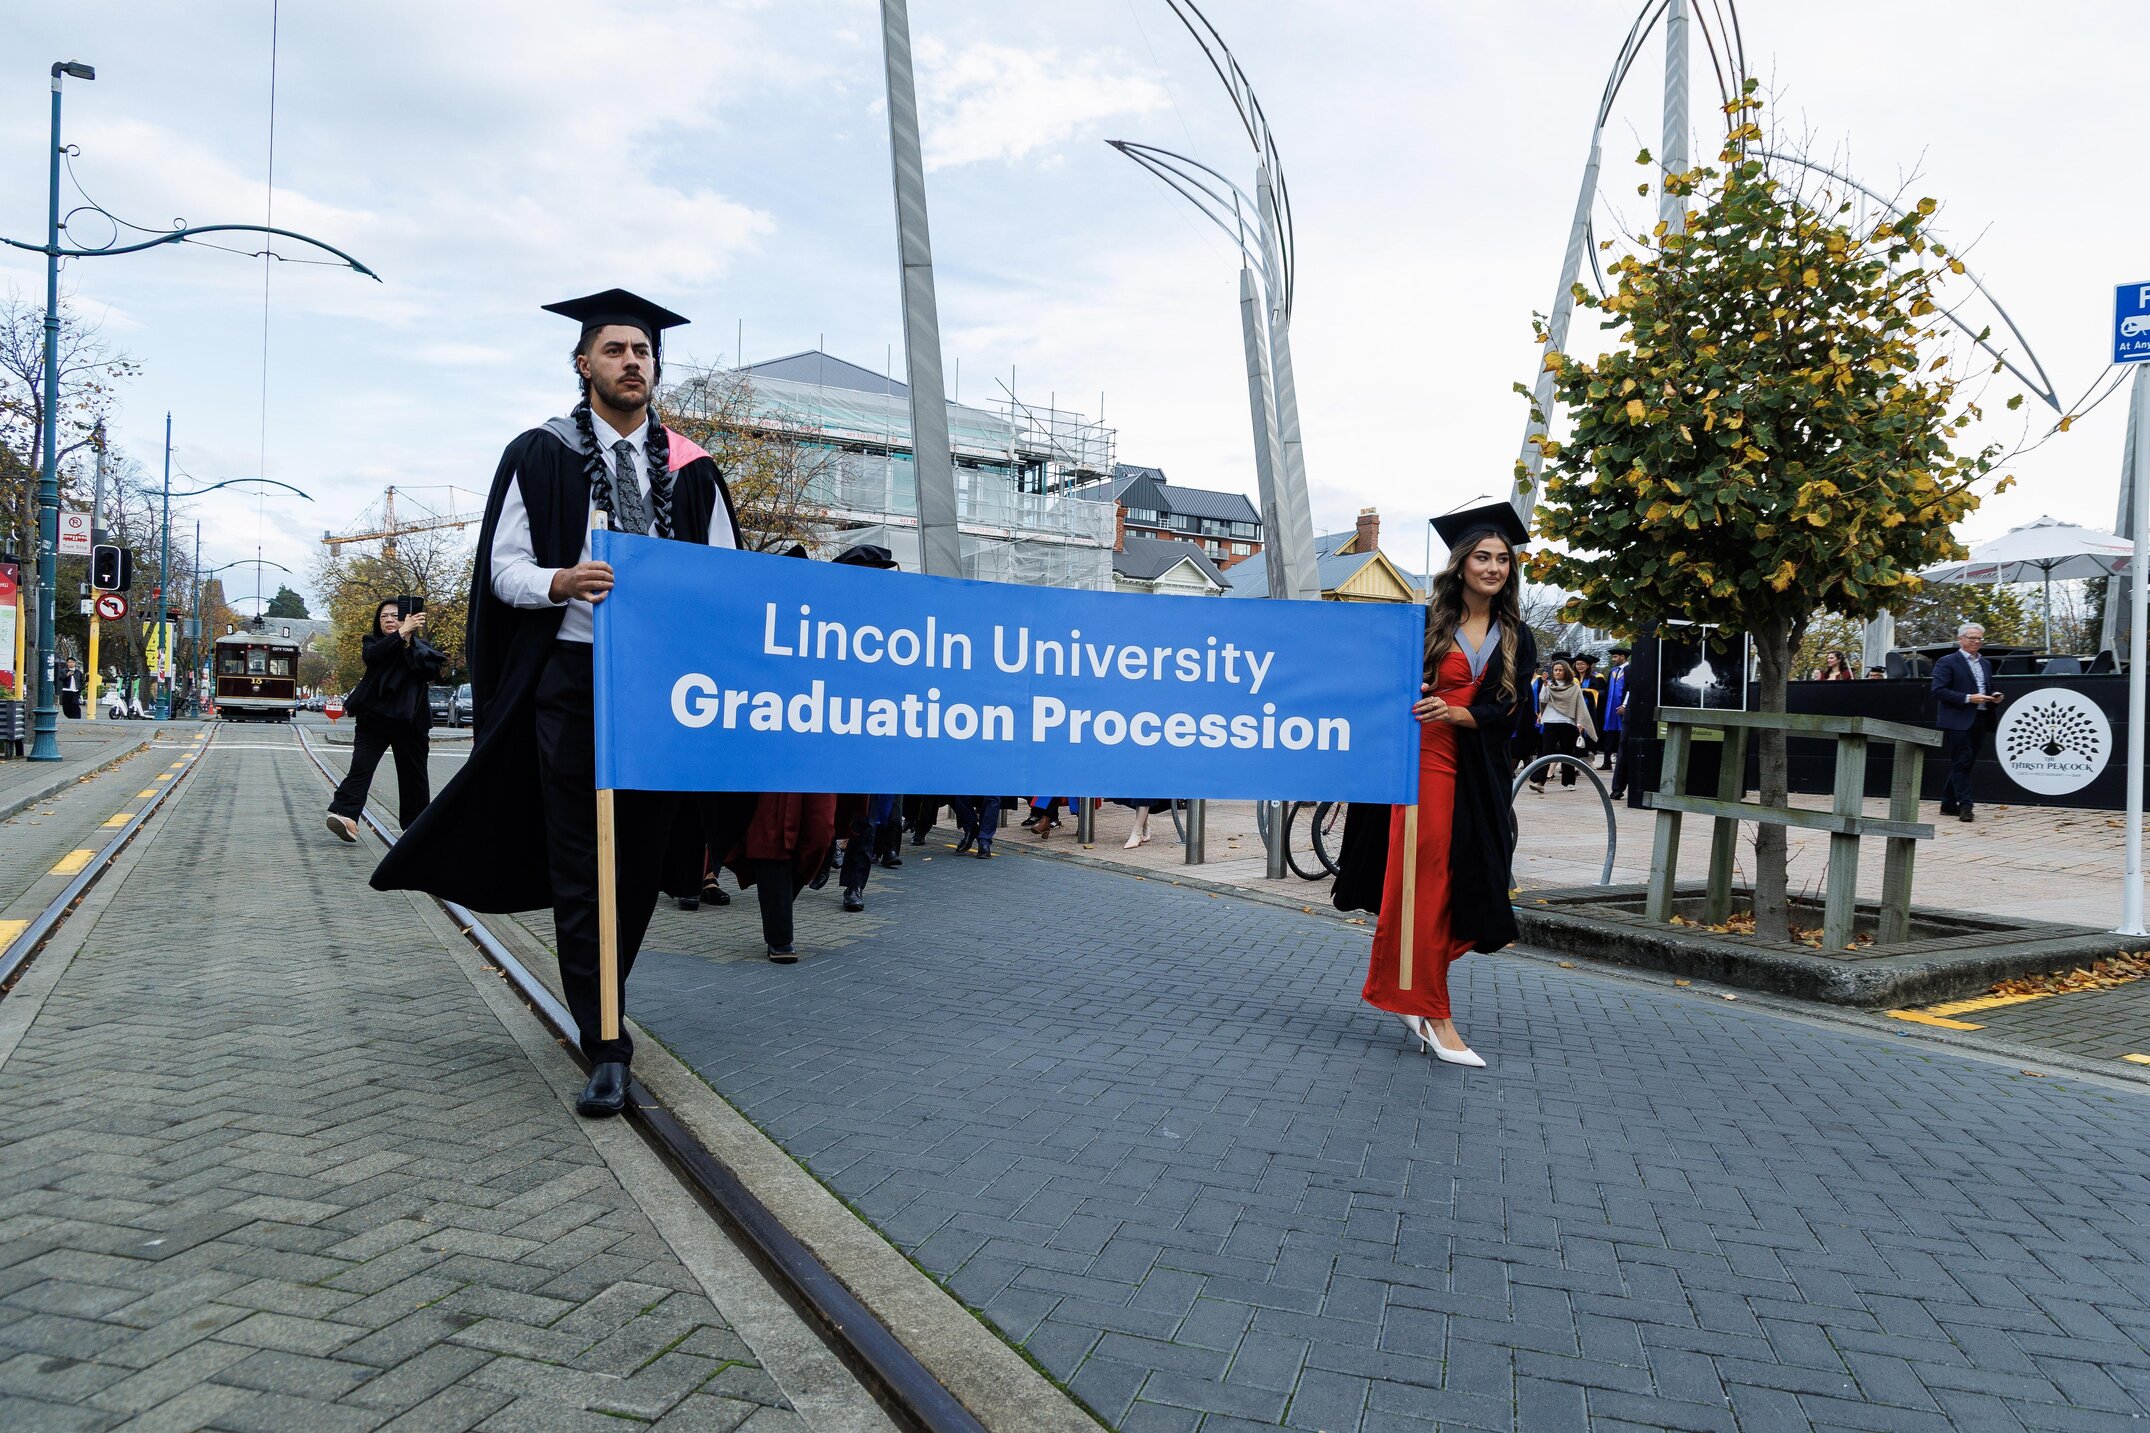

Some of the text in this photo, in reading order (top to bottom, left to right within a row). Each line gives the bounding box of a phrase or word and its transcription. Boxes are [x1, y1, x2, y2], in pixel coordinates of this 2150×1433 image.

[2119, 342, 2131, 351] At
[227, 625, 233, 634] B
[283, 628, 289, 637] B
[764, 602, 1275, 694] Lincoln University
[670, 672, 1351, 751] Graduation Procession
[2011, 762, 2094, 772] THIRSTY PEACOCK
